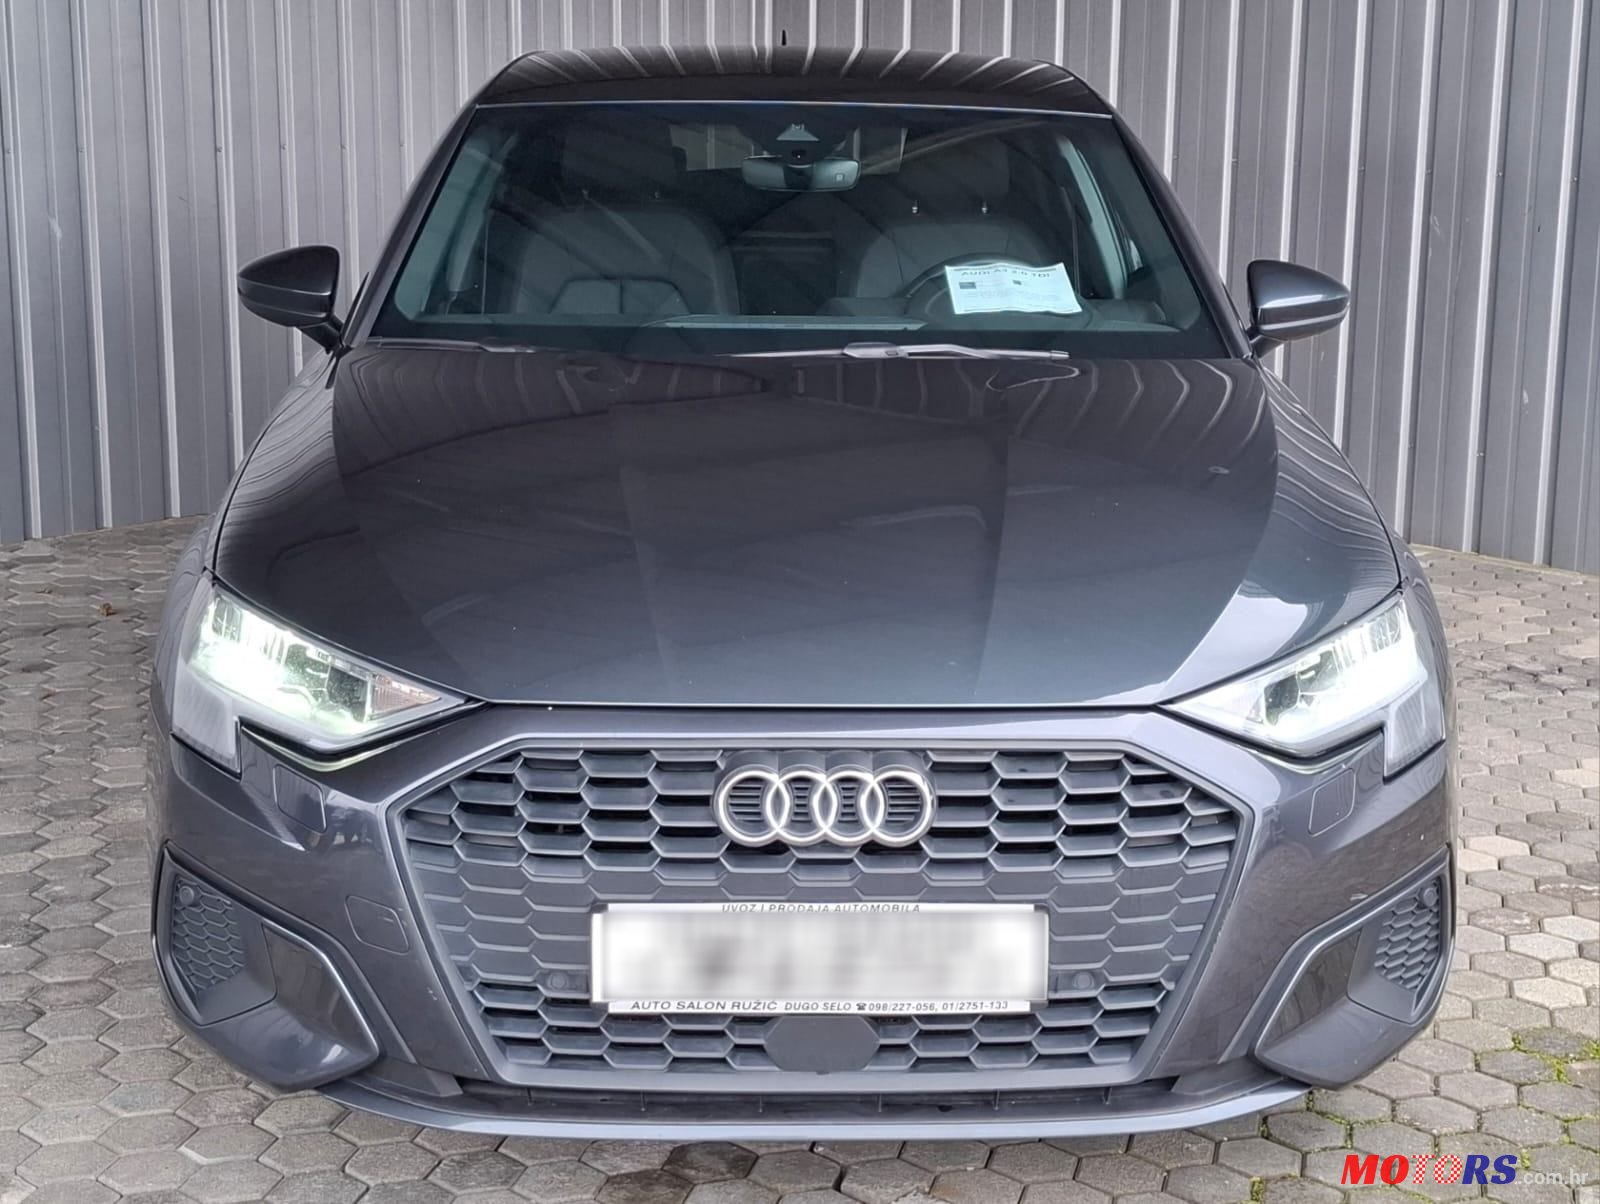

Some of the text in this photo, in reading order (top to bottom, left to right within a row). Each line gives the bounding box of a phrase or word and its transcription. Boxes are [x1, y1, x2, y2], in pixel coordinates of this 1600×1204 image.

[722, 904, 757, 913] UVOZ
[769, 904, 829, 913] PRODAJA
[834, 904, 920, 913] AUTOMOBILA
[631, 1001, 671, 1010] AUTO
[676, 1001, 726, 1010] SALON
[731, 999, 778, 1010] RUŽIĆ
[784, 1002, 819, 1011] DUGO
[822, 1002, 852, 1011] SELO
[942, 1001, 1009, 1011] 01/2751-133
